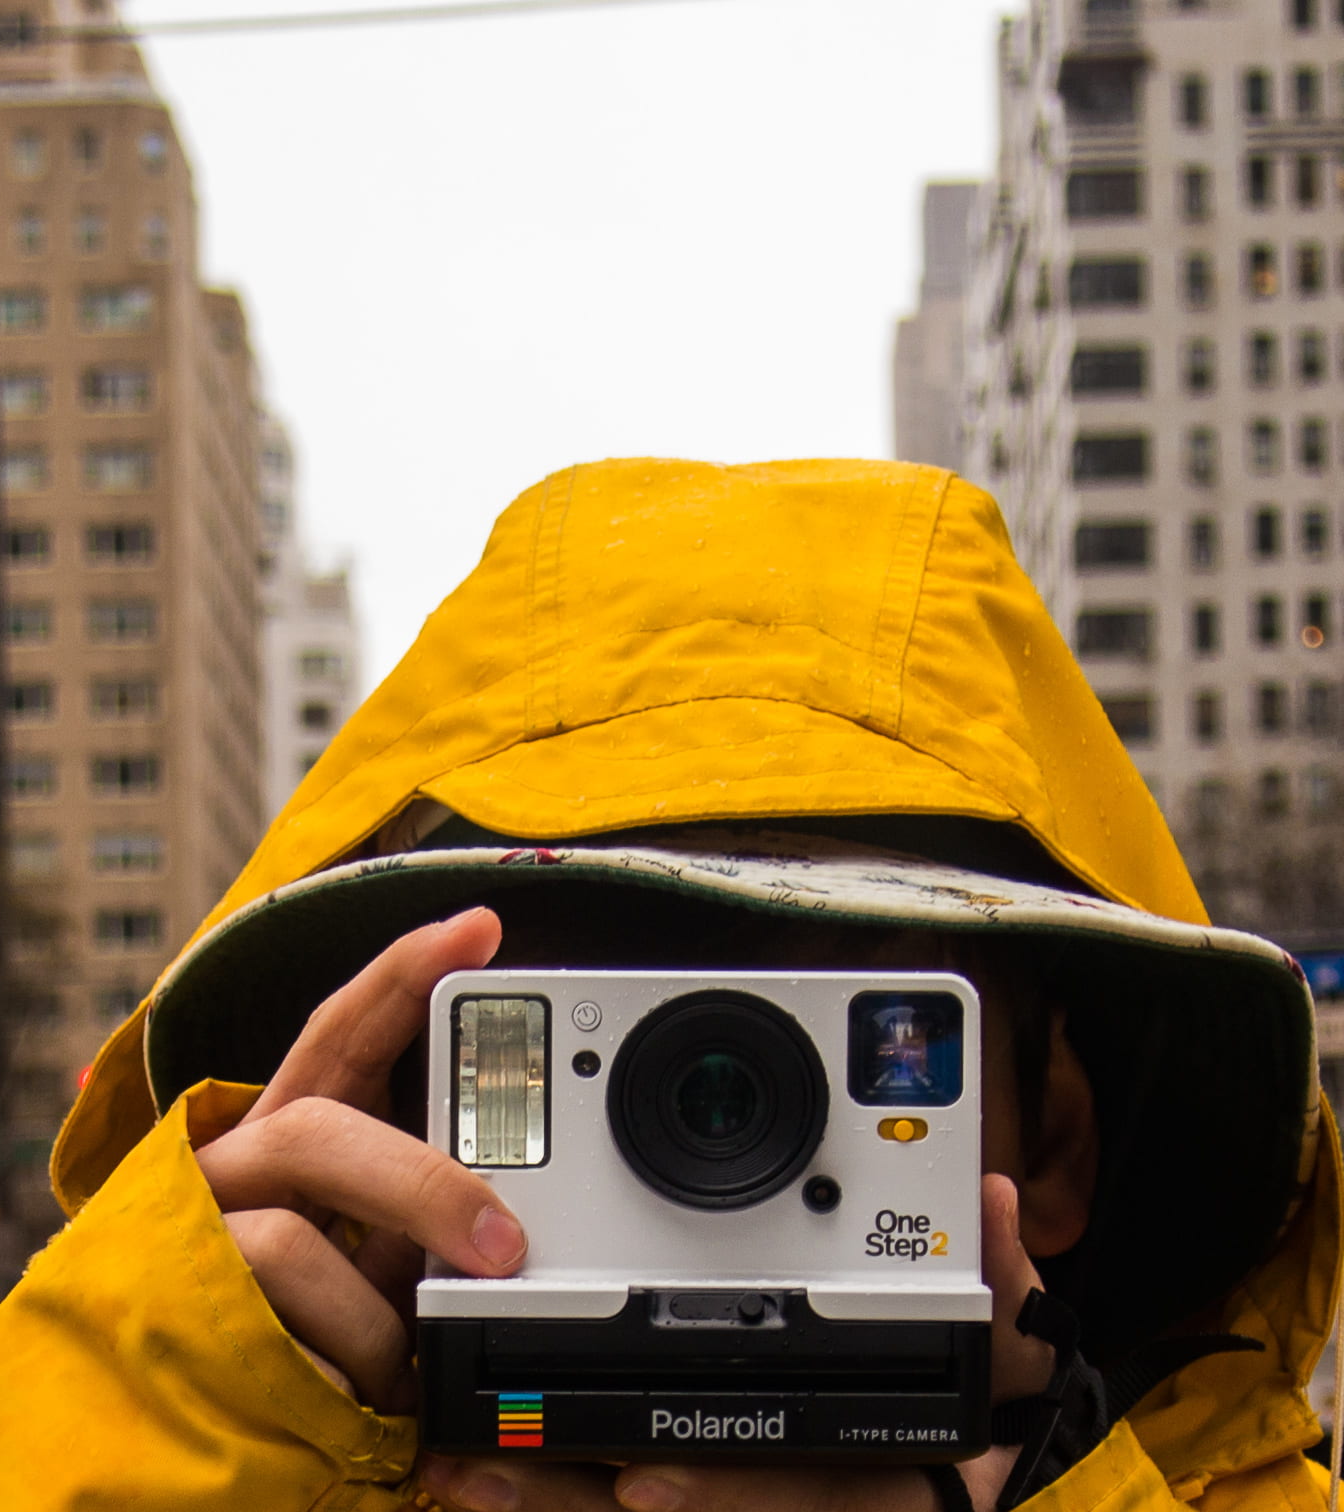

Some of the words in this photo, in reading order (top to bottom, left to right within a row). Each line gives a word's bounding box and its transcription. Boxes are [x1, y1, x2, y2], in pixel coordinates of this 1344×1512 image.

[875, 1209, 931, 1234] One
[652, 1409, 785, 1439] Polaroid
[839, 1428, 889, 1441] I-TYPE
[895, 1428, 959, 1441] CAMERA
